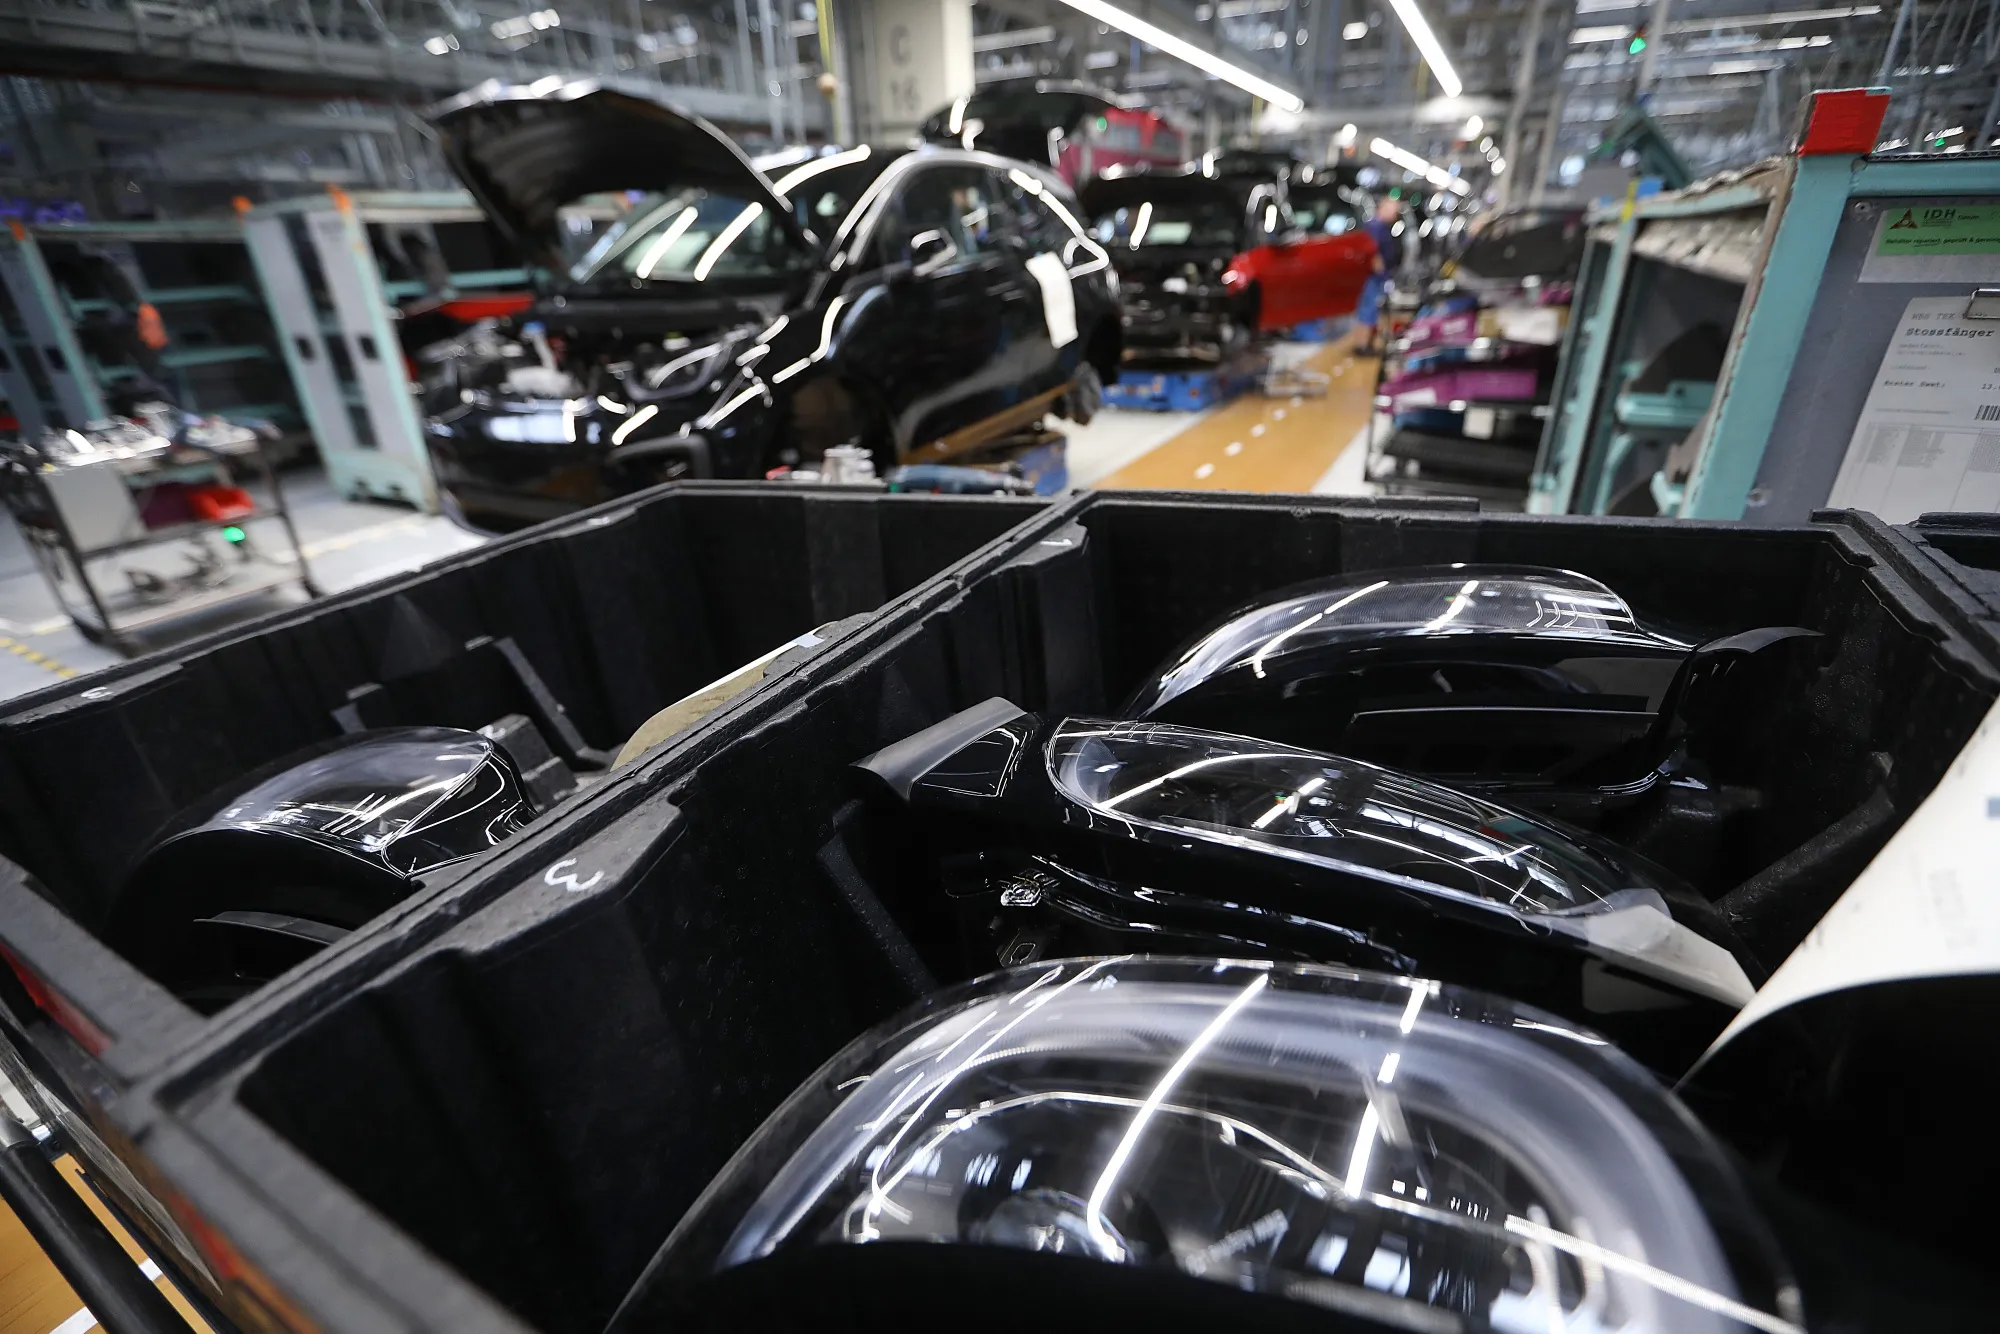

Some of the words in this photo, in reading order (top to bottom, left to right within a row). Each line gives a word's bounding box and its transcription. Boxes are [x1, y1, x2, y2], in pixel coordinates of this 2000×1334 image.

[889, 25, 911, 67] C
[1923, 208, 1957, 219] IDH
[1906, 327, 1995, 338] Stossfänger
[545, 857, 605, 892] 3
